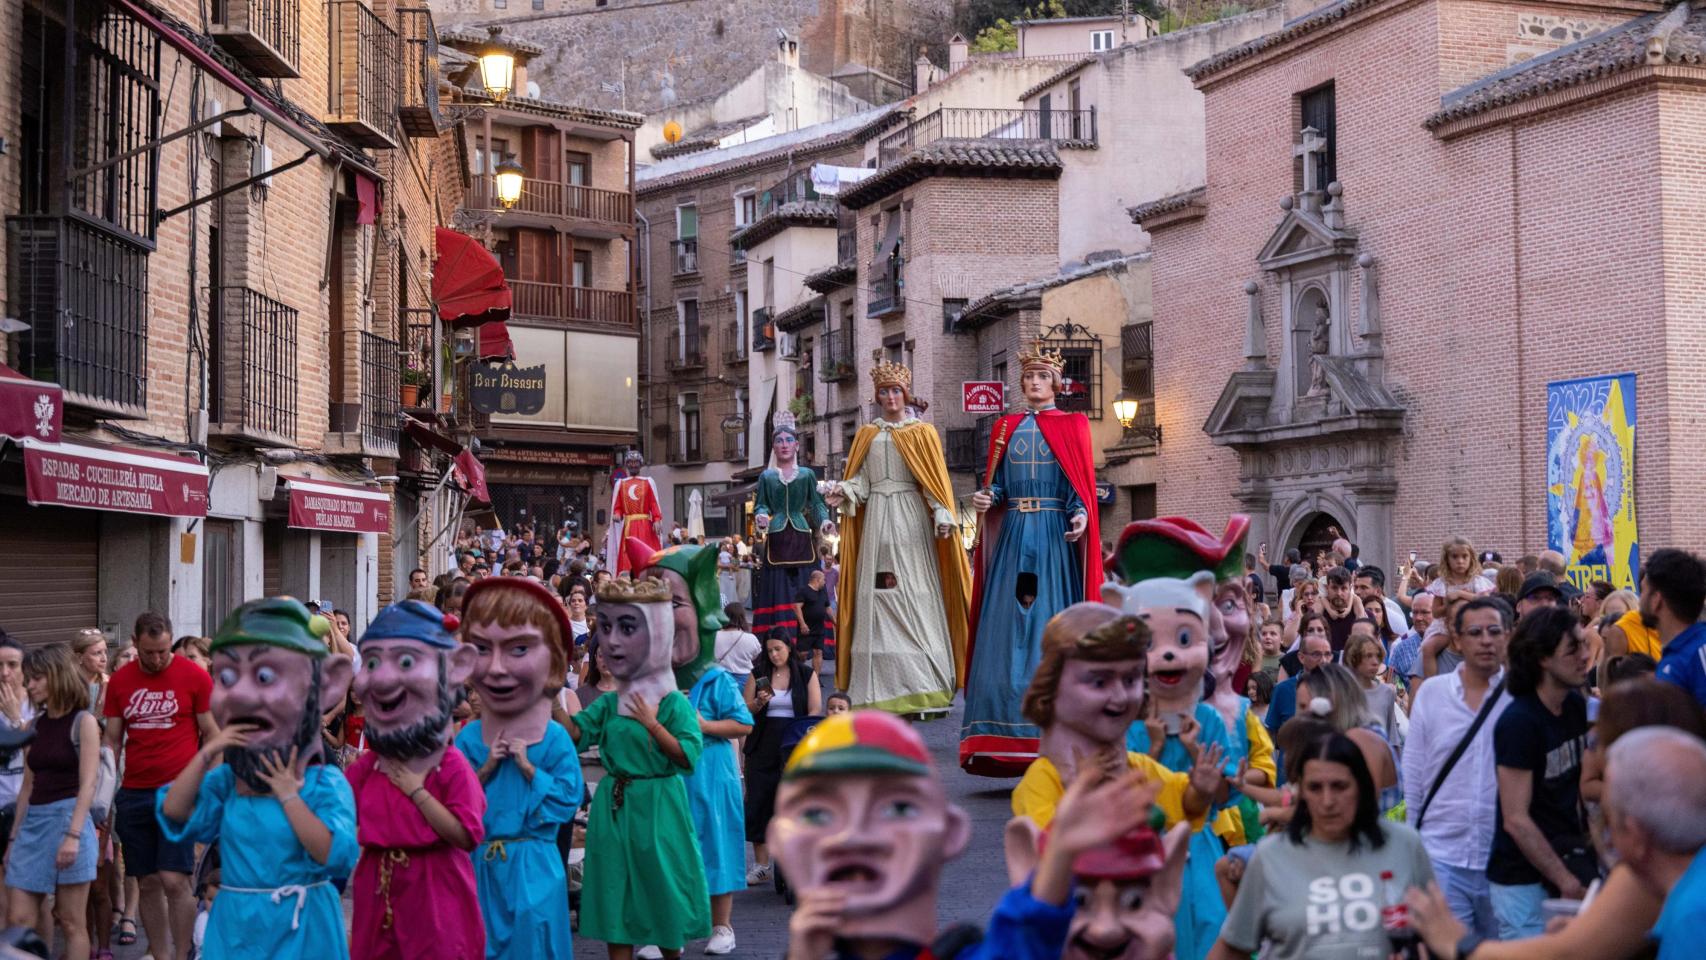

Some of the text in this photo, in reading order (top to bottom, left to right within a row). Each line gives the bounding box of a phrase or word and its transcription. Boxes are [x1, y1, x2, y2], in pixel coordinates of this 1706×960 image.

[474, 372, 544, 389] Bar Bisagra
[41, 458, 80, 480] ESPADAS
[86, 466, 137, 488] CUCHILLERÍA
[138, 473, 164, 492] MUELA
[57, 483, 153, 509] MERCADO DE ARTESANÍA
[304, 496, 364, 514] DAMASQUINADO DE TOLEDO
[315, 512, 356, 528] PERLAS MAJORICA
[1308, 873, 1374, 904] SO
[1306, 901, 1379, 935] HO
